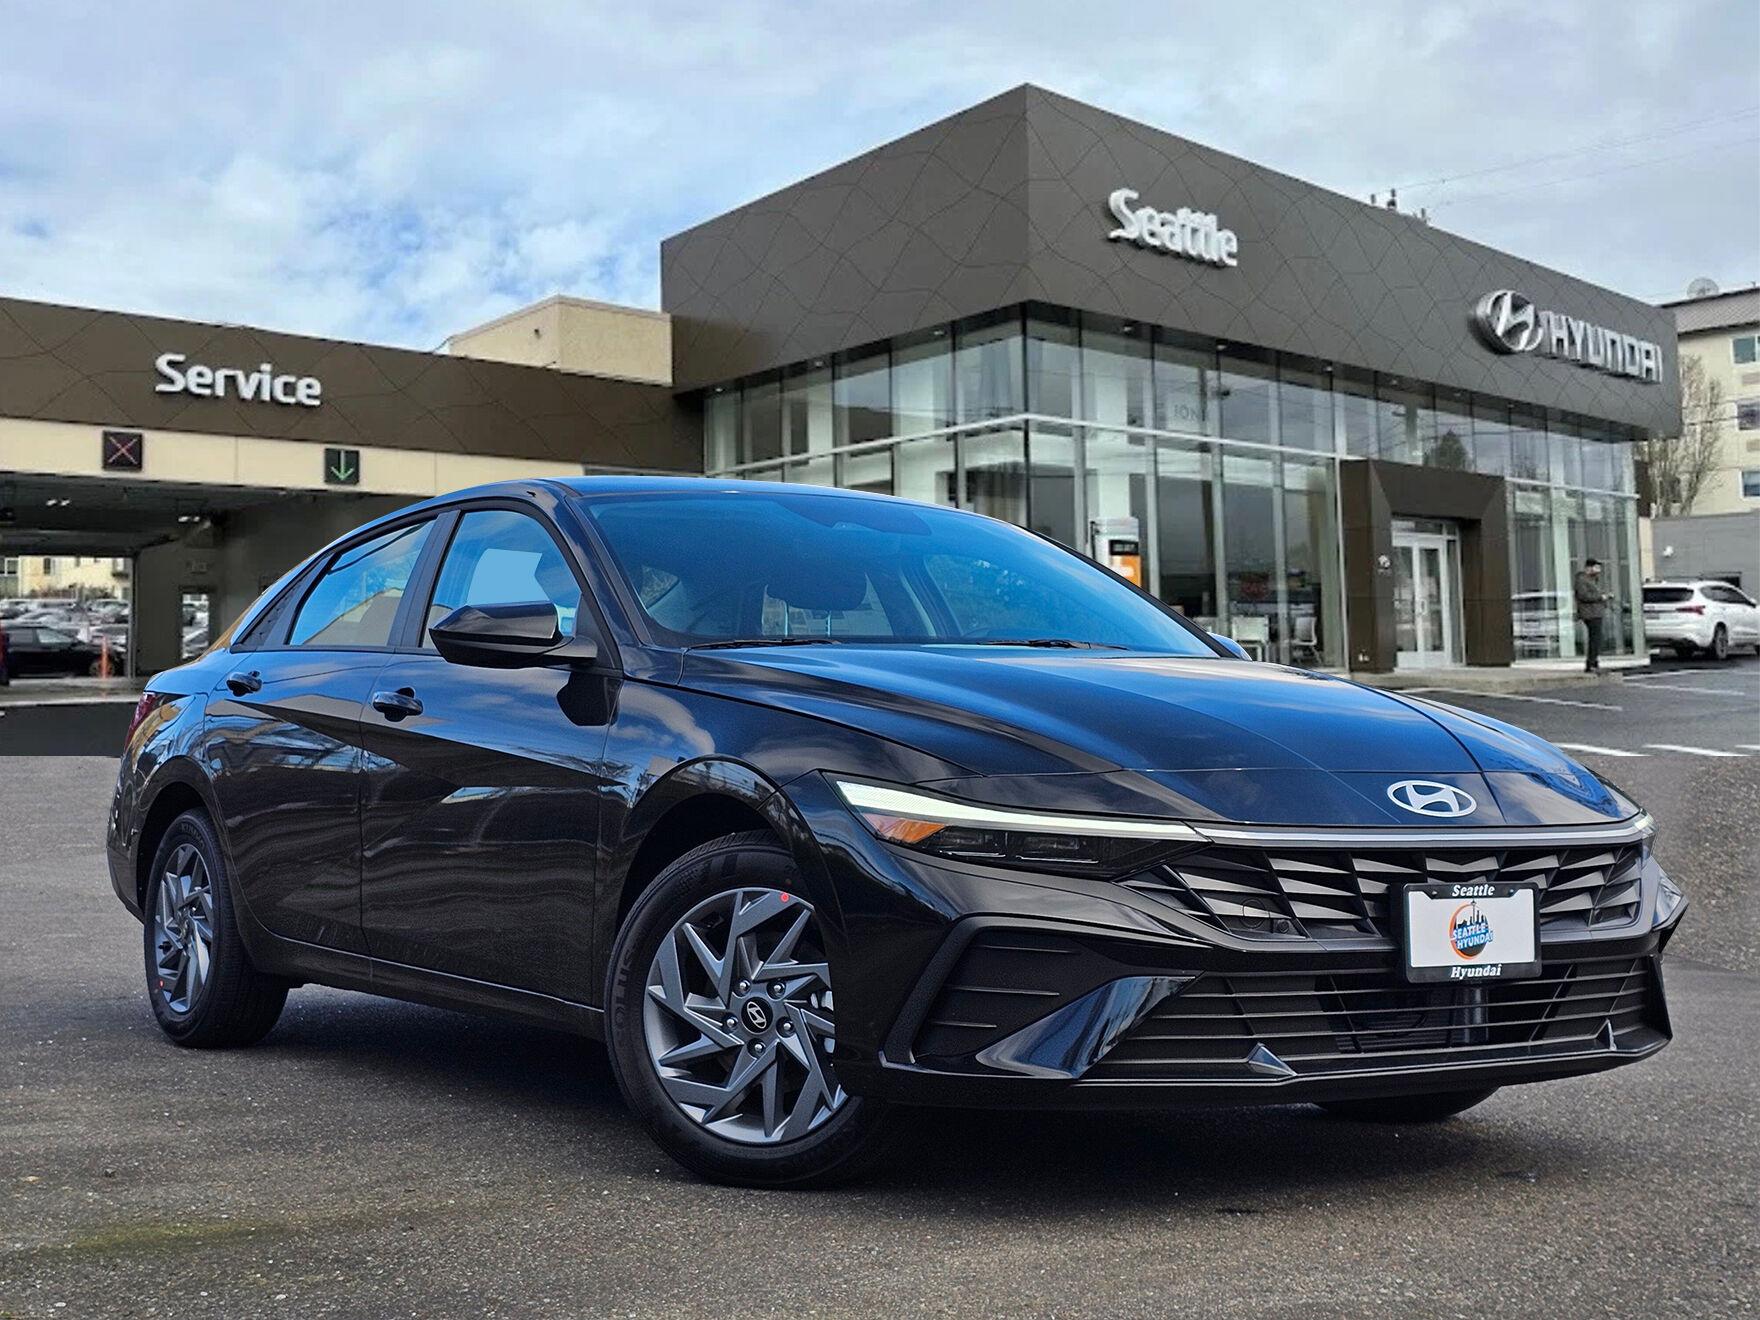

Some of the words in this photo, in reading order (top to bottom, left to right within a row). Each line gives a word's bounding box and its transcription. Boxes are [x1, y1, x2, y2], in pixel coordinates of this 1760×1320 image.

[1108, 188, 1238, 267] Seattle
[1542, 311, 1663, 383] HYUNDAI
[155, 353, 322, 406] Service
[1451, 884, 1495, 897] Seattle
[1452, 923, 1487, 940] SEATTLE
[1456, 930, 1494, 950] HYUNDAI
[1450, 964, 1502, 980] Hyundai
